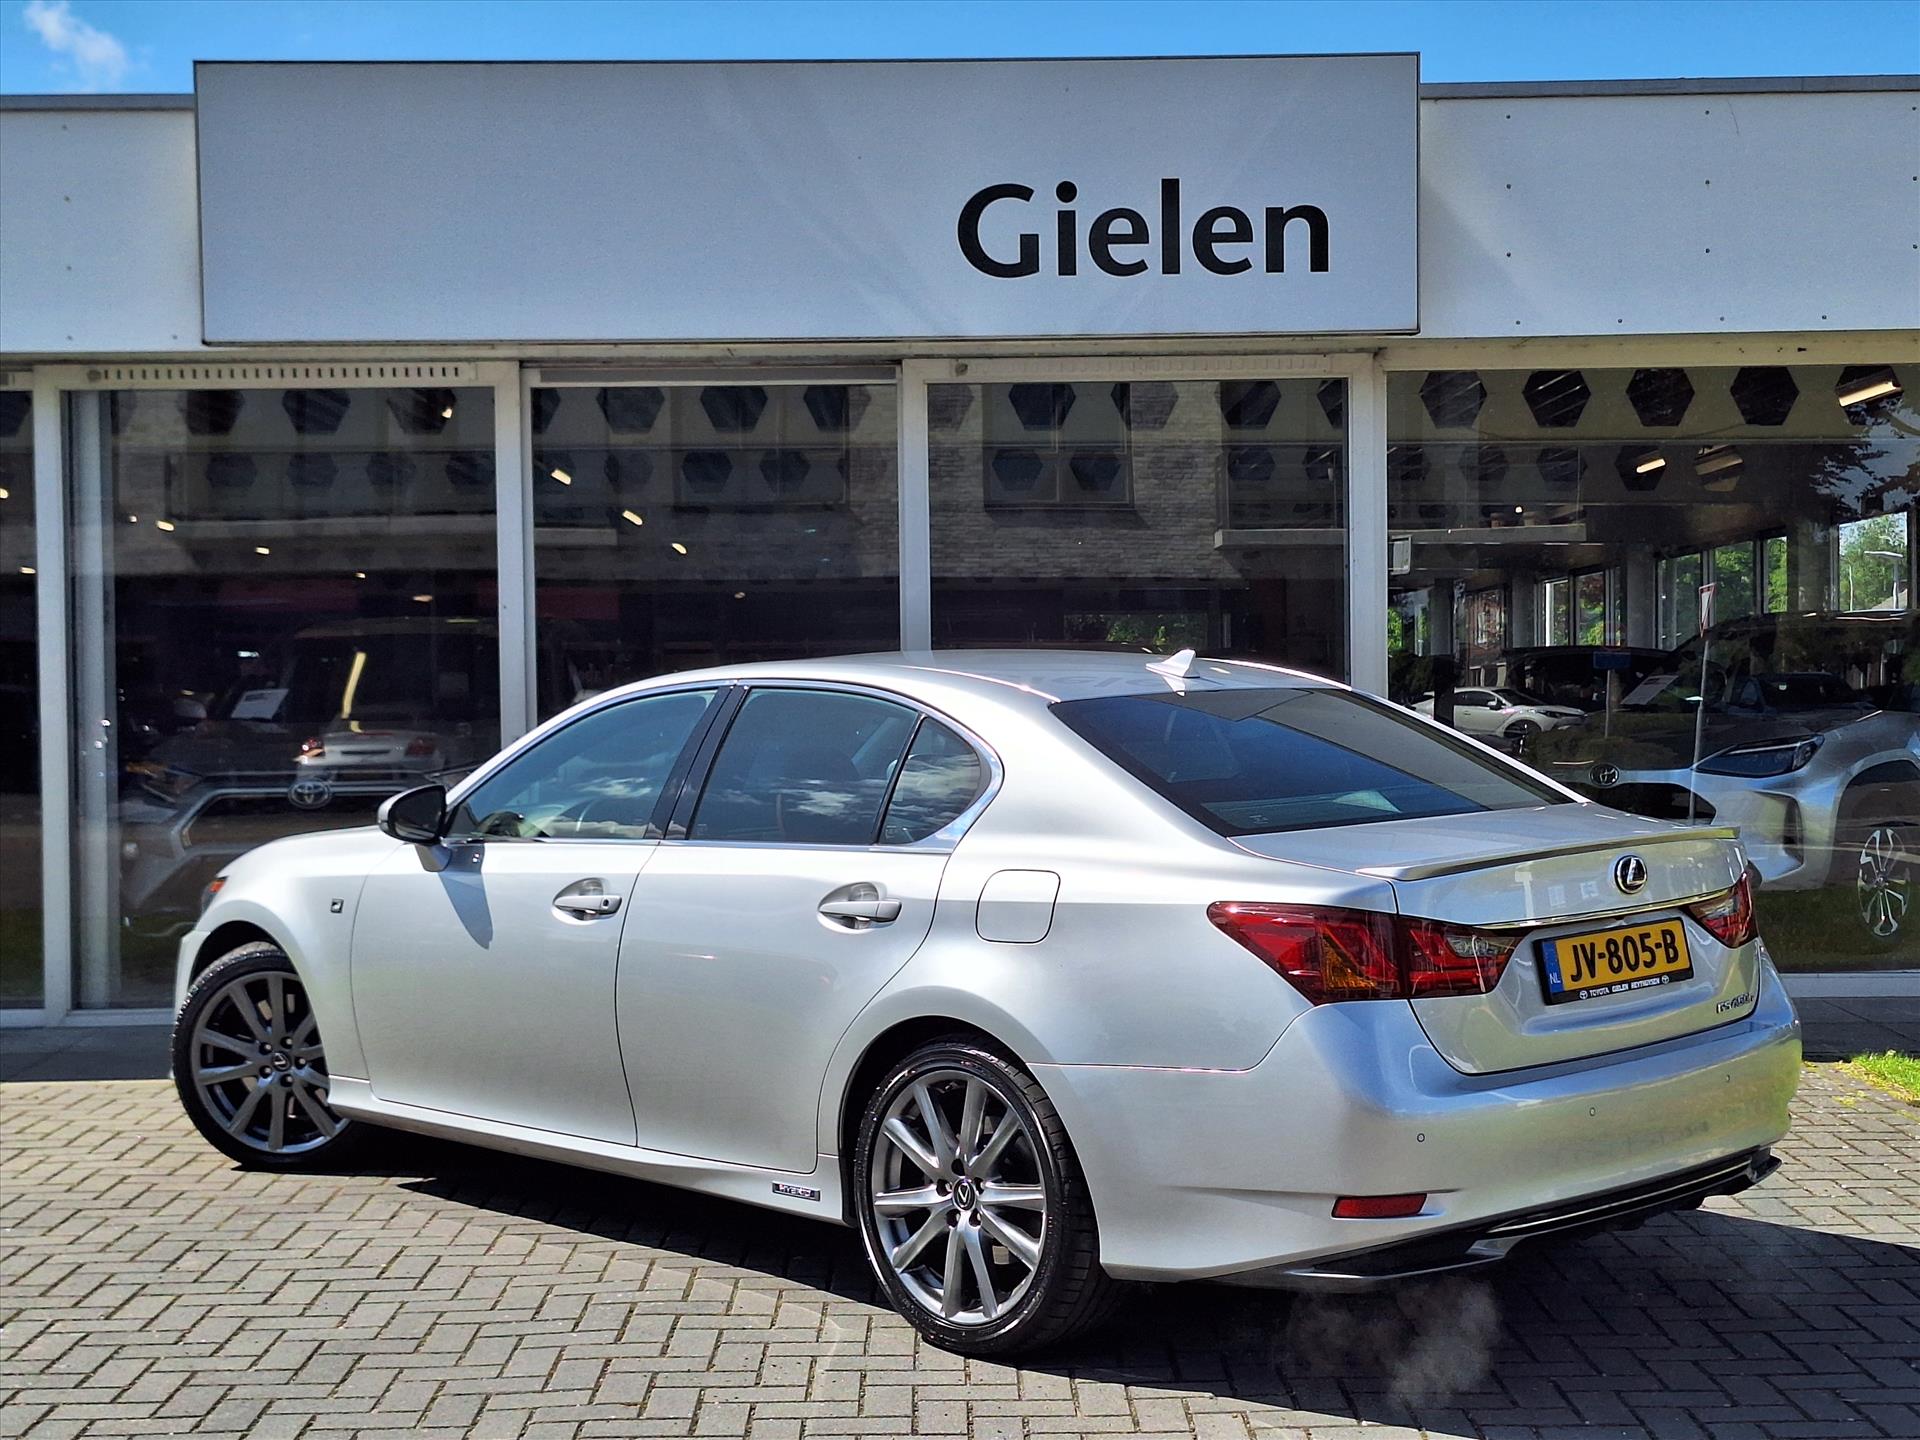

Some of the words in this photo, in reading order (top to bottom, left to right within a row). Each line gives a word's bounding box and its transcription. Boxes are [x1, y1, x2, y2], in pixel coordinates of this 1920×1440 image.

[957, 177, 1330, 278] Gielen
[1570, 928, 1679, 983] JV-805-B
[1549, 971, 1561, 985] NL
[1589, 987, 1610, 997] TOYOTA
